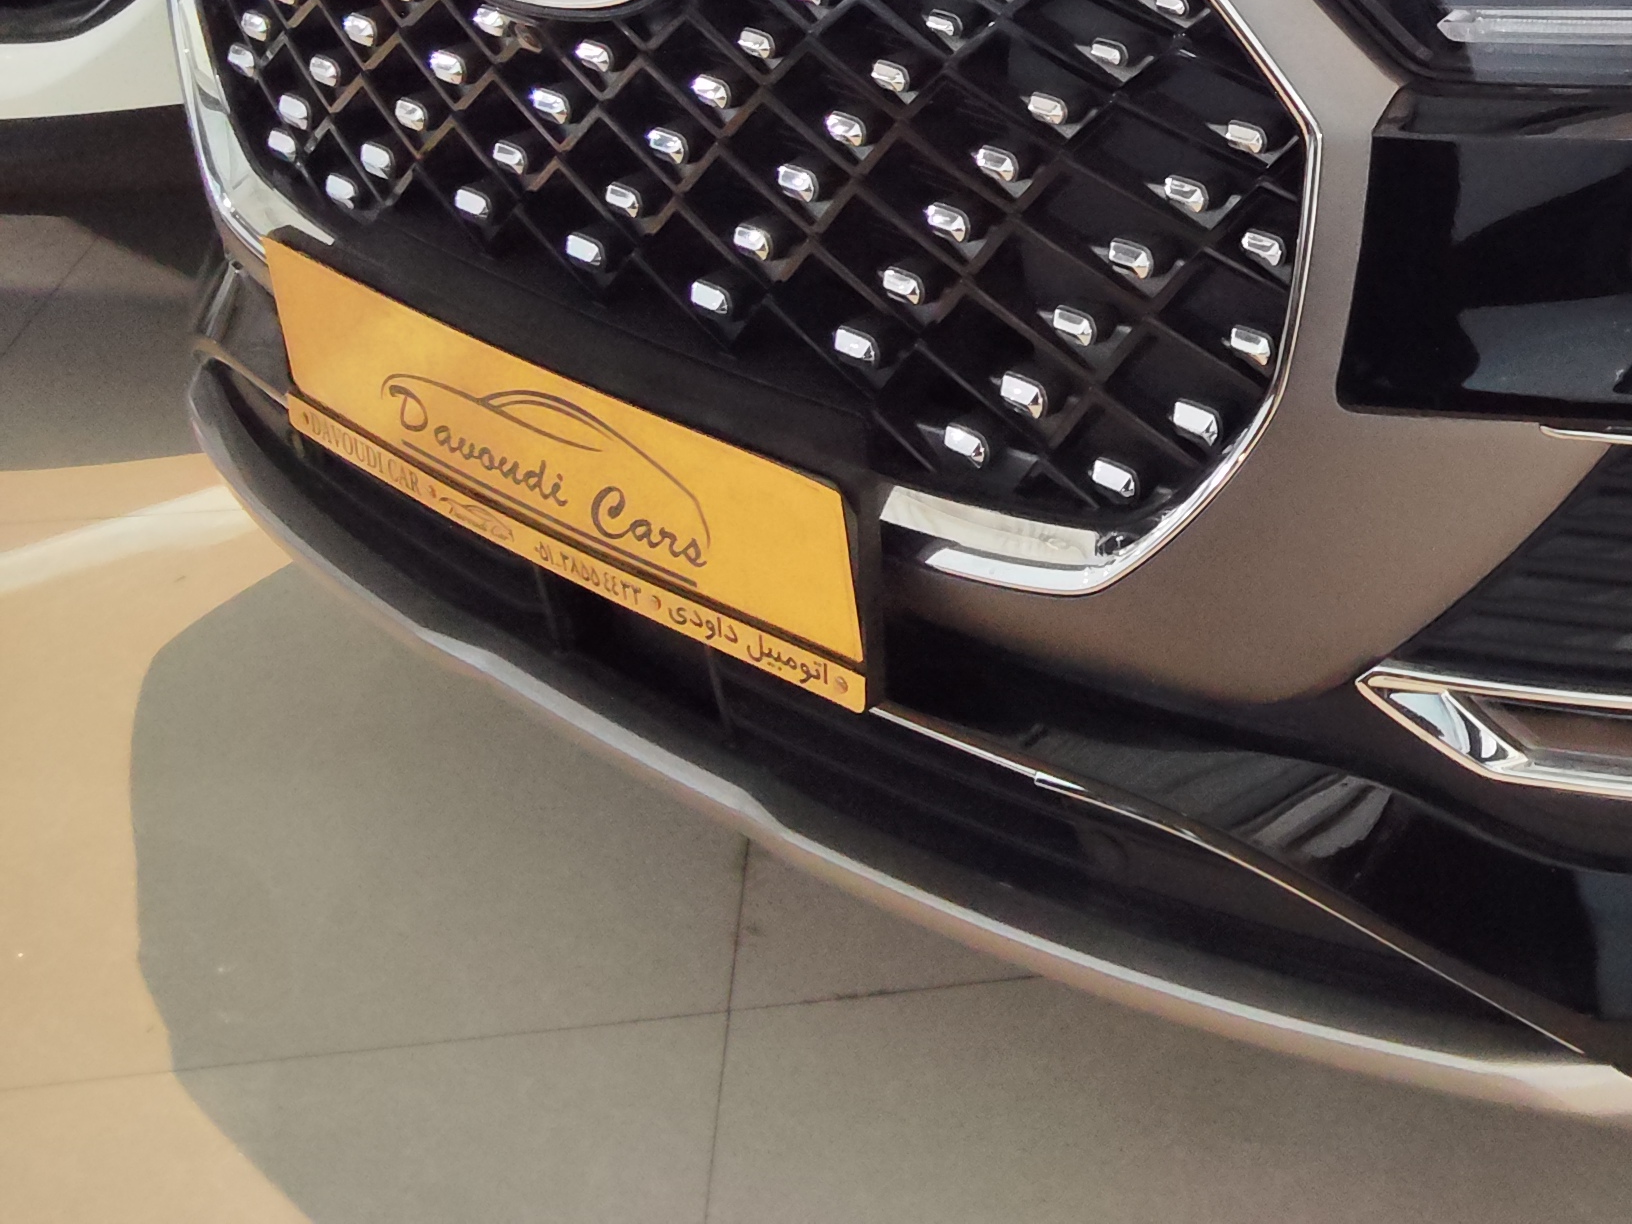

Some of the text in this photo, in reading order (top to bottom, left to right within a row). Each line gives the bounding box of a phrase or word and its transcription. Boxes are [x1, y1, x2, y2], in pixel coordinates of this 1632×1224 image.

[310, 411, 422, 497] DAVOUDI CAR
[389, 384, 708, 568] Davoudi Cars
[667, 606, 829, 685] اتومبیل داودی
